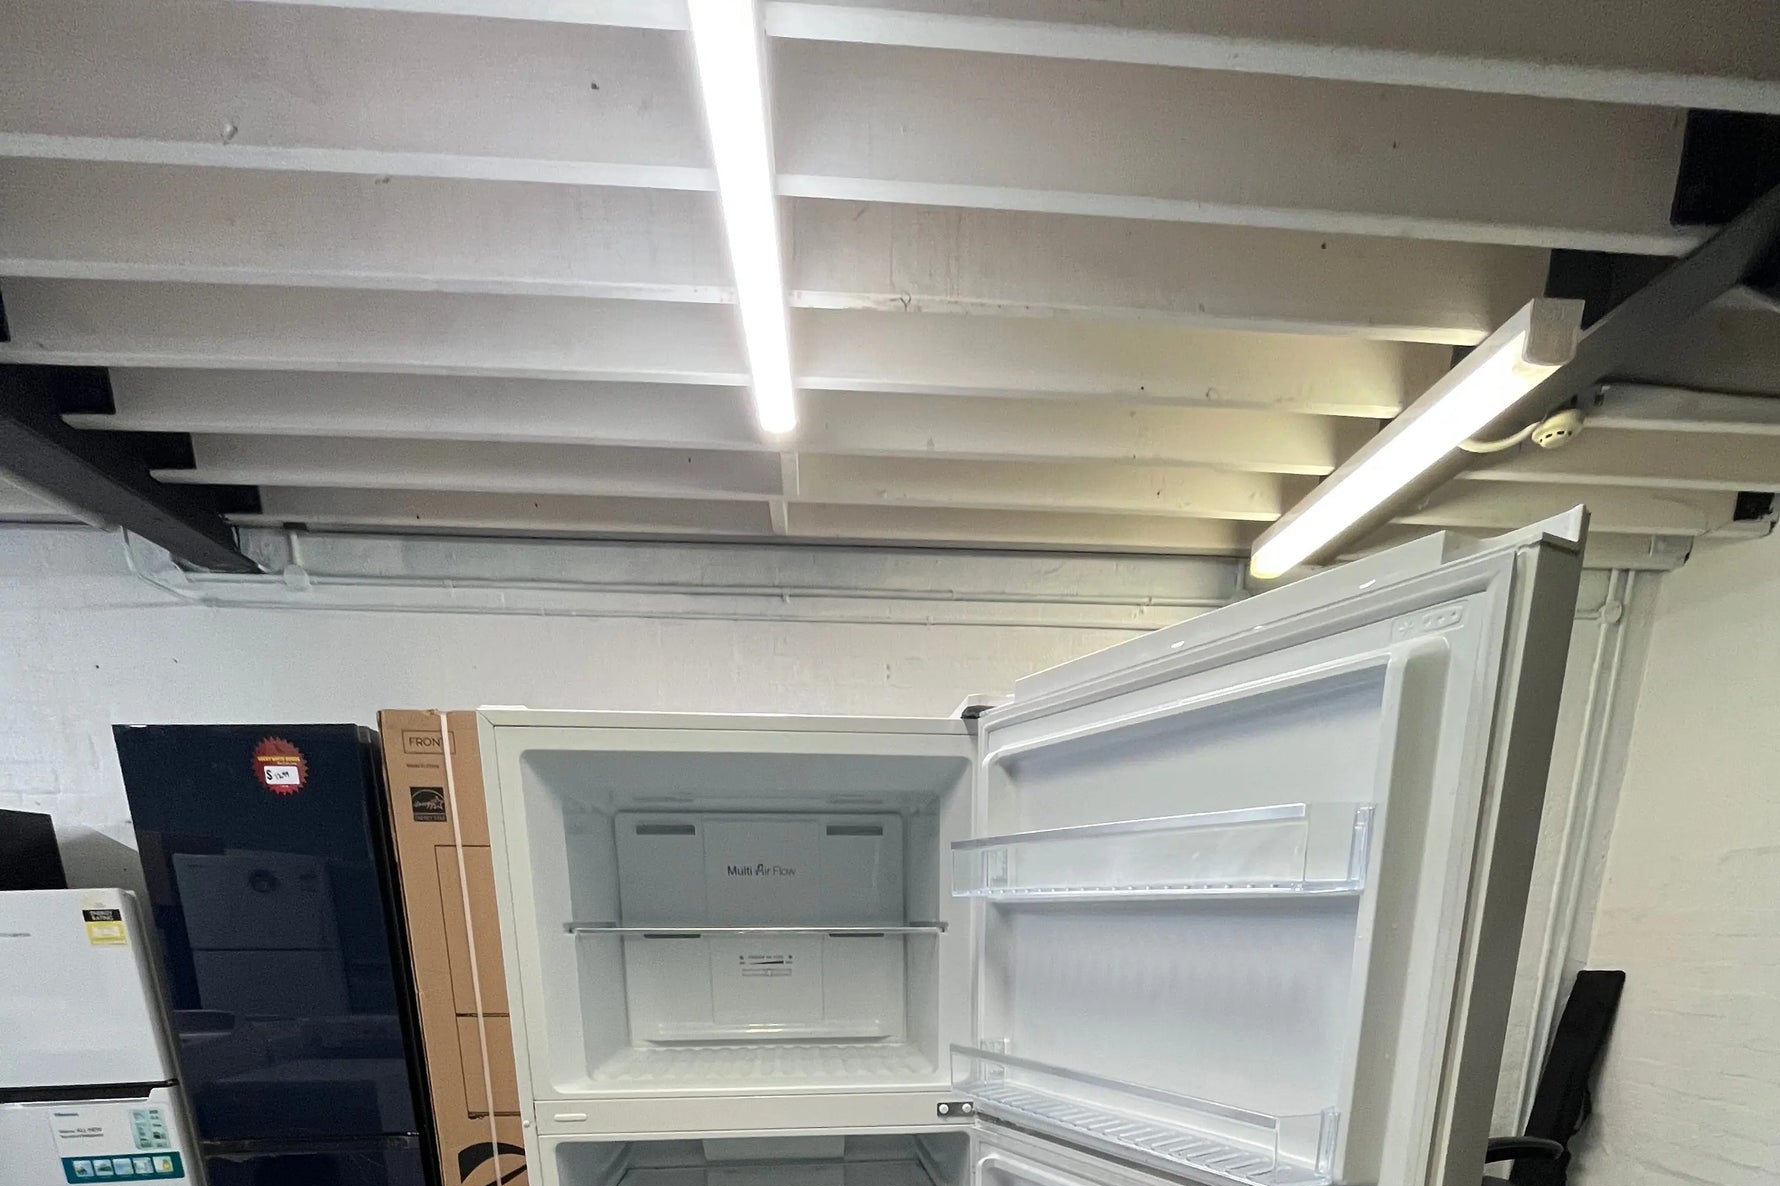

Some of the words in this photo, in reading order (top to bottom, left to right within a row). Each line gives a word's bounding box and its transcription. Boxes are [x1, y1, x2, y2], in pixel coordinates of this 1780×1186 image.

[409, 737, 443, 747] FRON
[727, 865, 753, 876] Multi
[756, 863, 770, 876] Air
[773, 865, 797, 876] Flow
